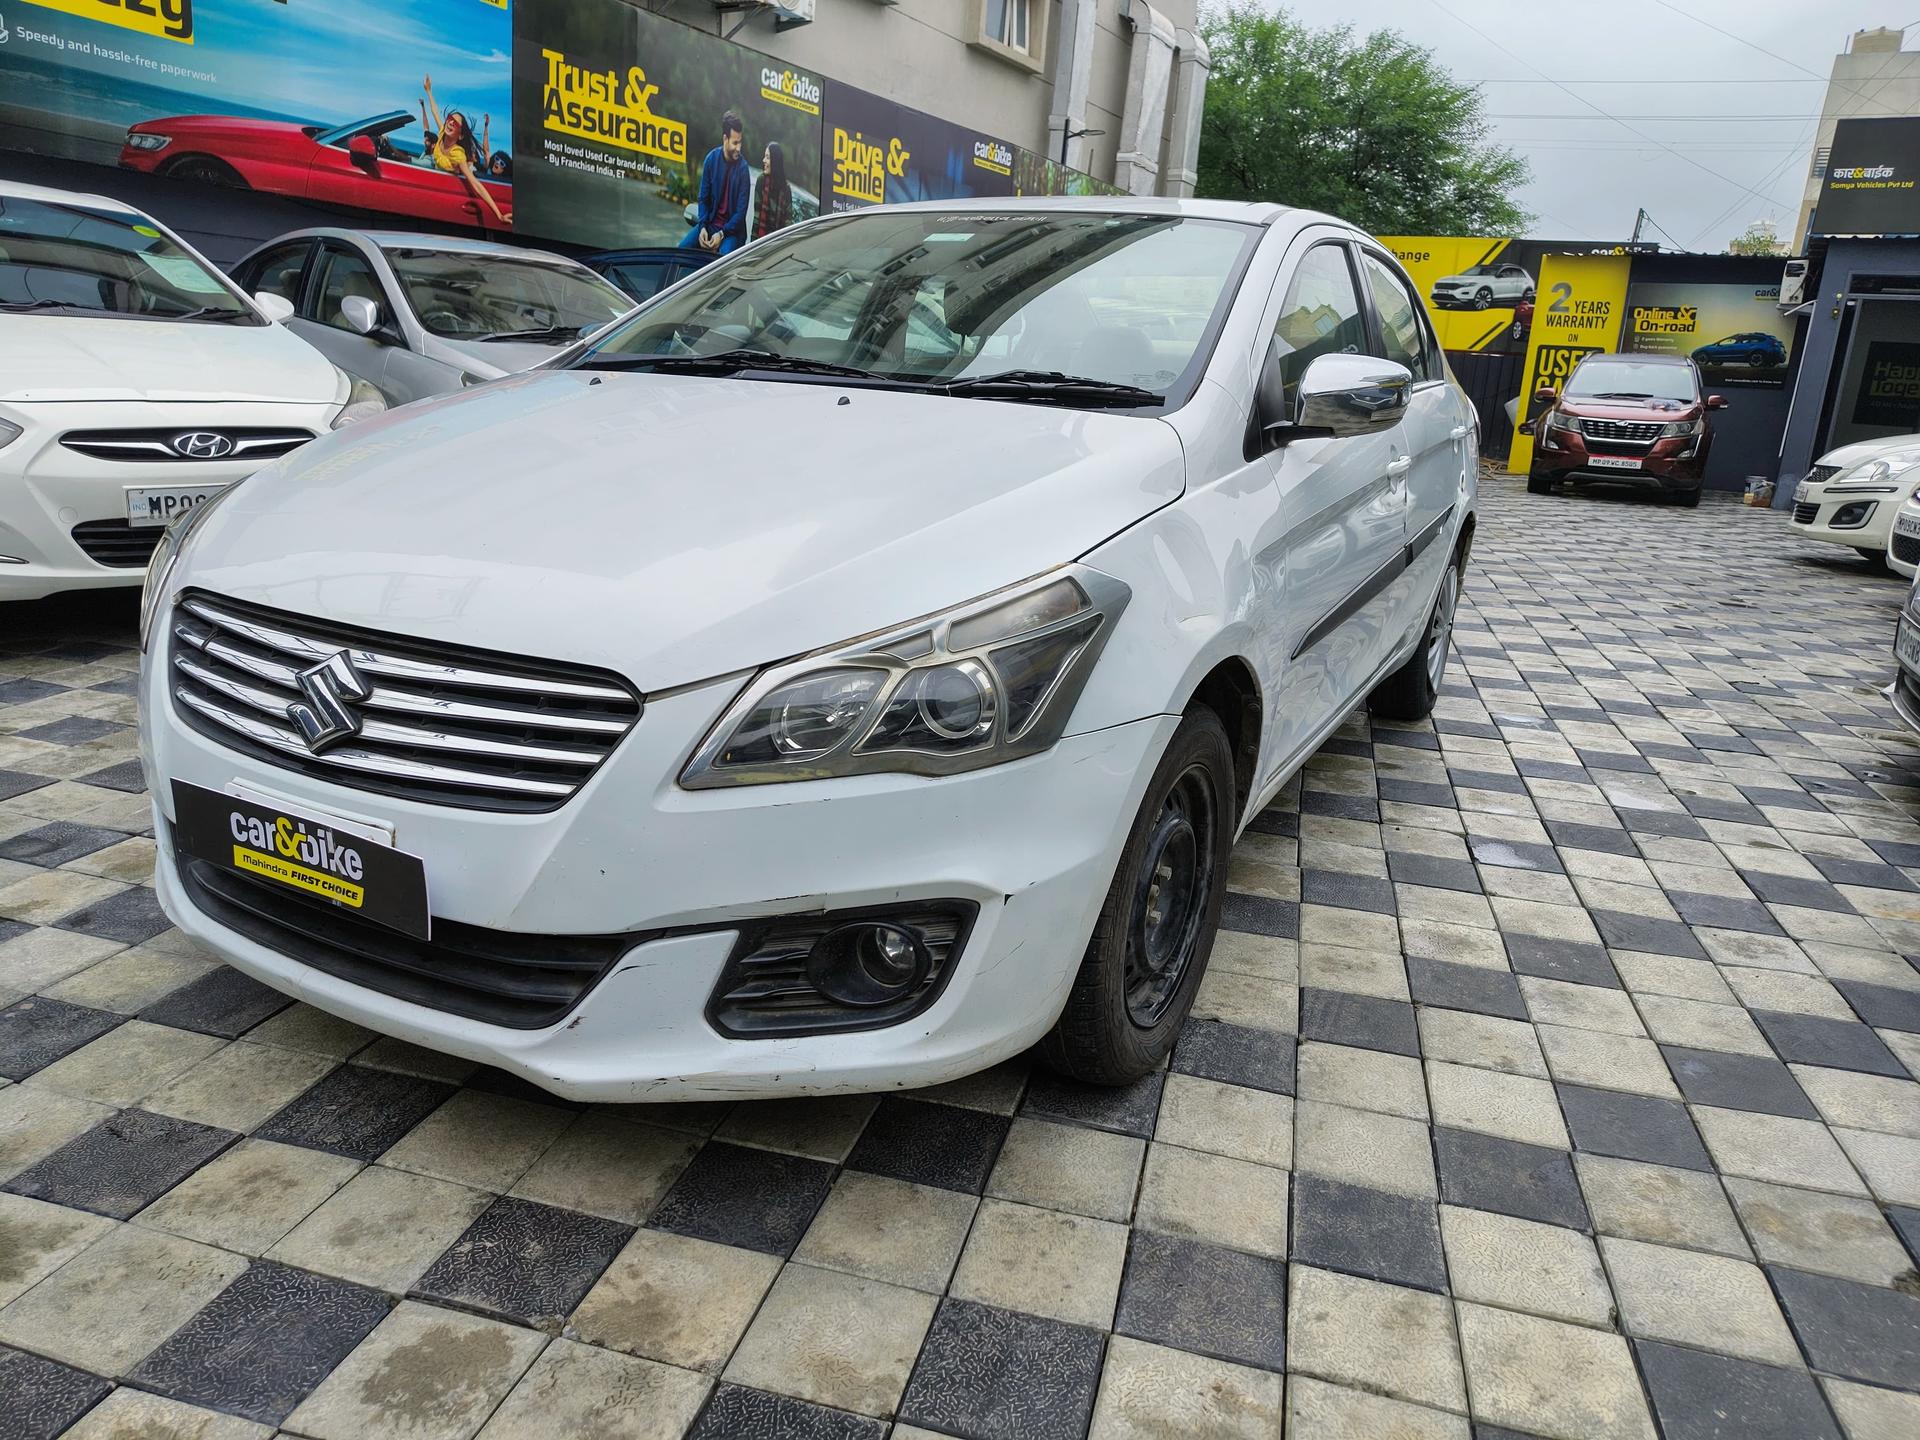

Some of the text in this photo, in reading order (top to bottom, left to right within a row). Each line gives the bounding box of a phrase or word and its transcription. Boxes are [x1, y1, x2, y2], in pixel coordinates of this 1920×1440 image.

[17, 26, 217, 83] Speedy and hassle-free paperwork
[542, 48, 659, 116] Trust &
[761, 67, 820, 103] car&bike
[544, 87, 684, 156] Assurance
[544, 139, 661, 176] Most loved Used Car brand of India
[549, 153, 626, 180] By Franchise India, ET
[834, 127, 910, 177] Drive &
[974, 141, 1012, 167] car&bike
[833, 159, 882, 198] Smile
[1856, 181, 1886, 189] Vehicles
[1548, 281, 1611, 315] 2 YEARS
[1633, 304, 1697, 320] Online &
[1546, 314, 1608, 329] WARRANTY
[1640, 320, 1696, 332] On-road
[1567, 333, 1579, 343] ON
[1539, 348, 1590, 377] USE
[132, 503, 147, 511] IND
[230, 811, 363, 881] car&bike
[290, 870, 321, 887] FIRST
[321, 880, 359, 900] CHOICE
